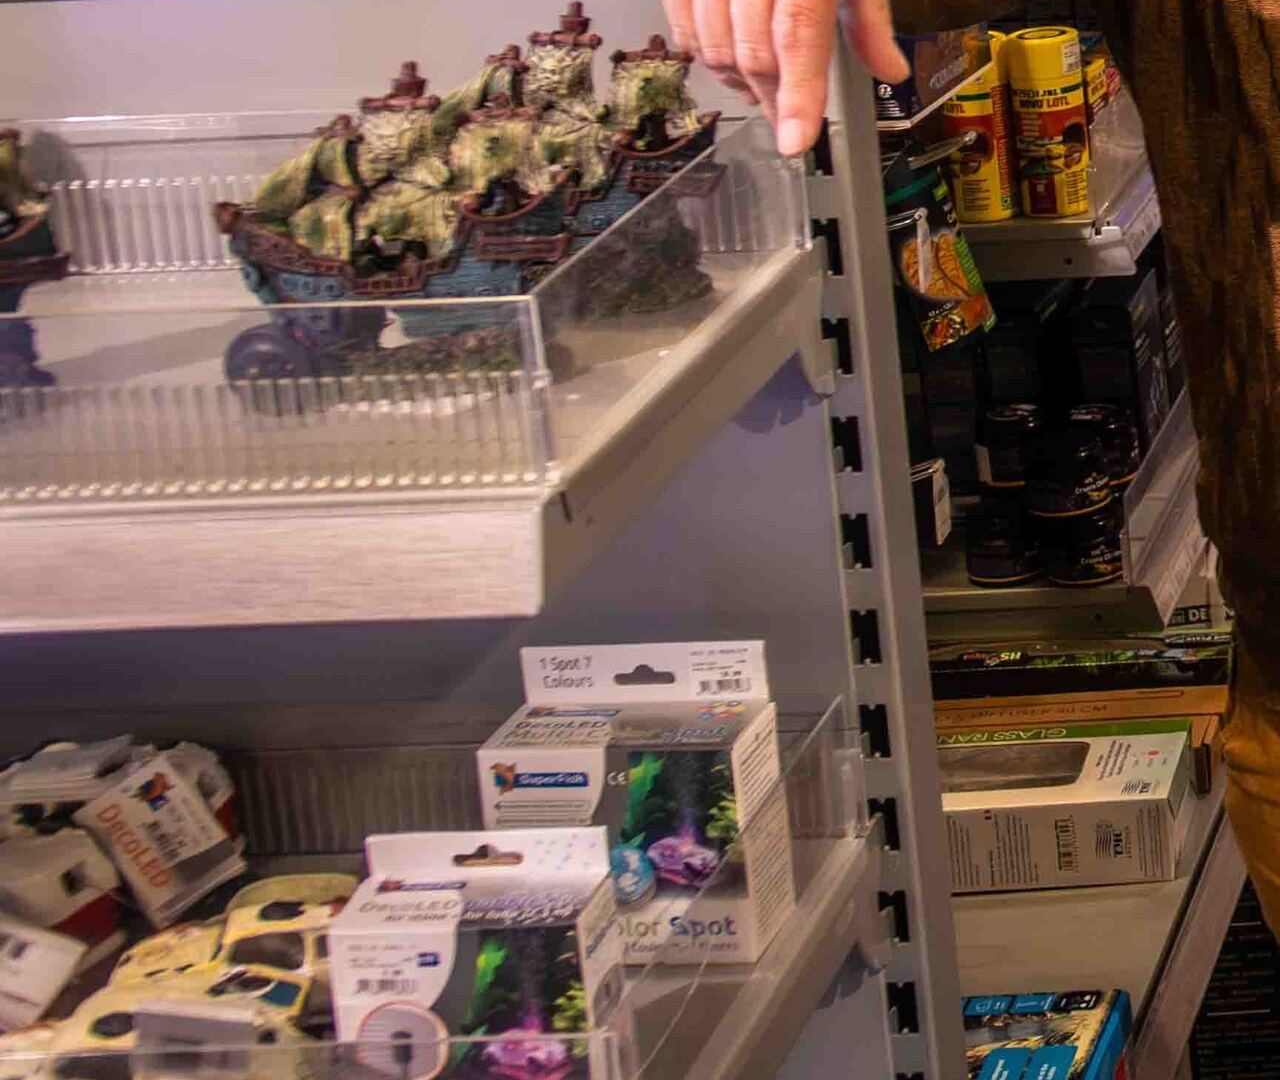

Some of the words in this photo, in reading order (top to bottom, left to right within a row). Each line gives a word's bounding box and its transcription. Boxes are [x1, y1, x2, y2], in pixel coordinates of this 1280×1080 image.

[549, 656, 583, 673] Spot
[543, 674, 594, 689] Colours
[936, 731, 987, 745] RAN
[992, 727, 1067, 743] GLASS
[607, 772, 627, 786] CE
[670, 916, 737, 940] Spot
